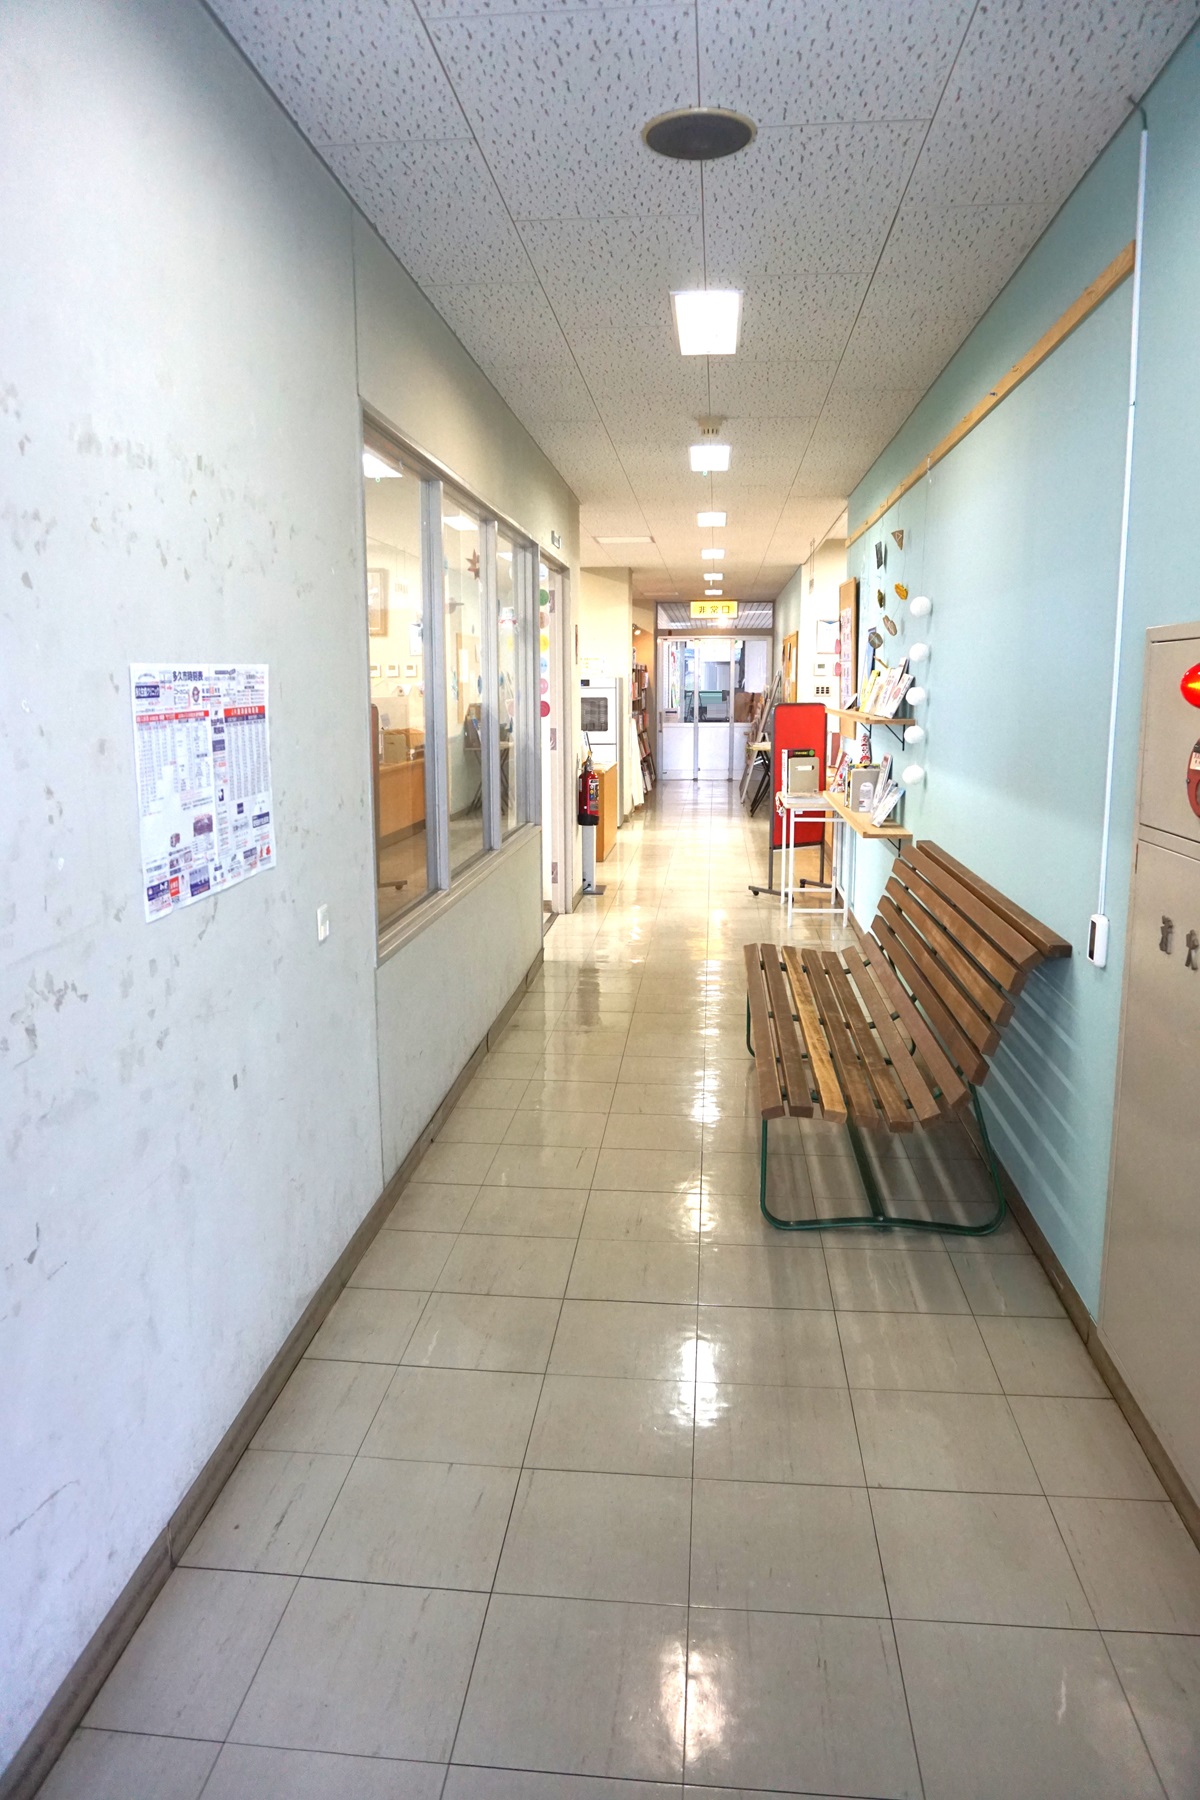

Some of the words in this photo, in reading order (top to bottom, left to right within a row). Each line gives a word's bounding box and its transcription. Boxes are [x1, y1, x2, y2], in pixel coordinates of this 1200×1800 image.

[699, 605, 730, 614] 非常口
[172, 671, 203, 682] 多久市時刻表
